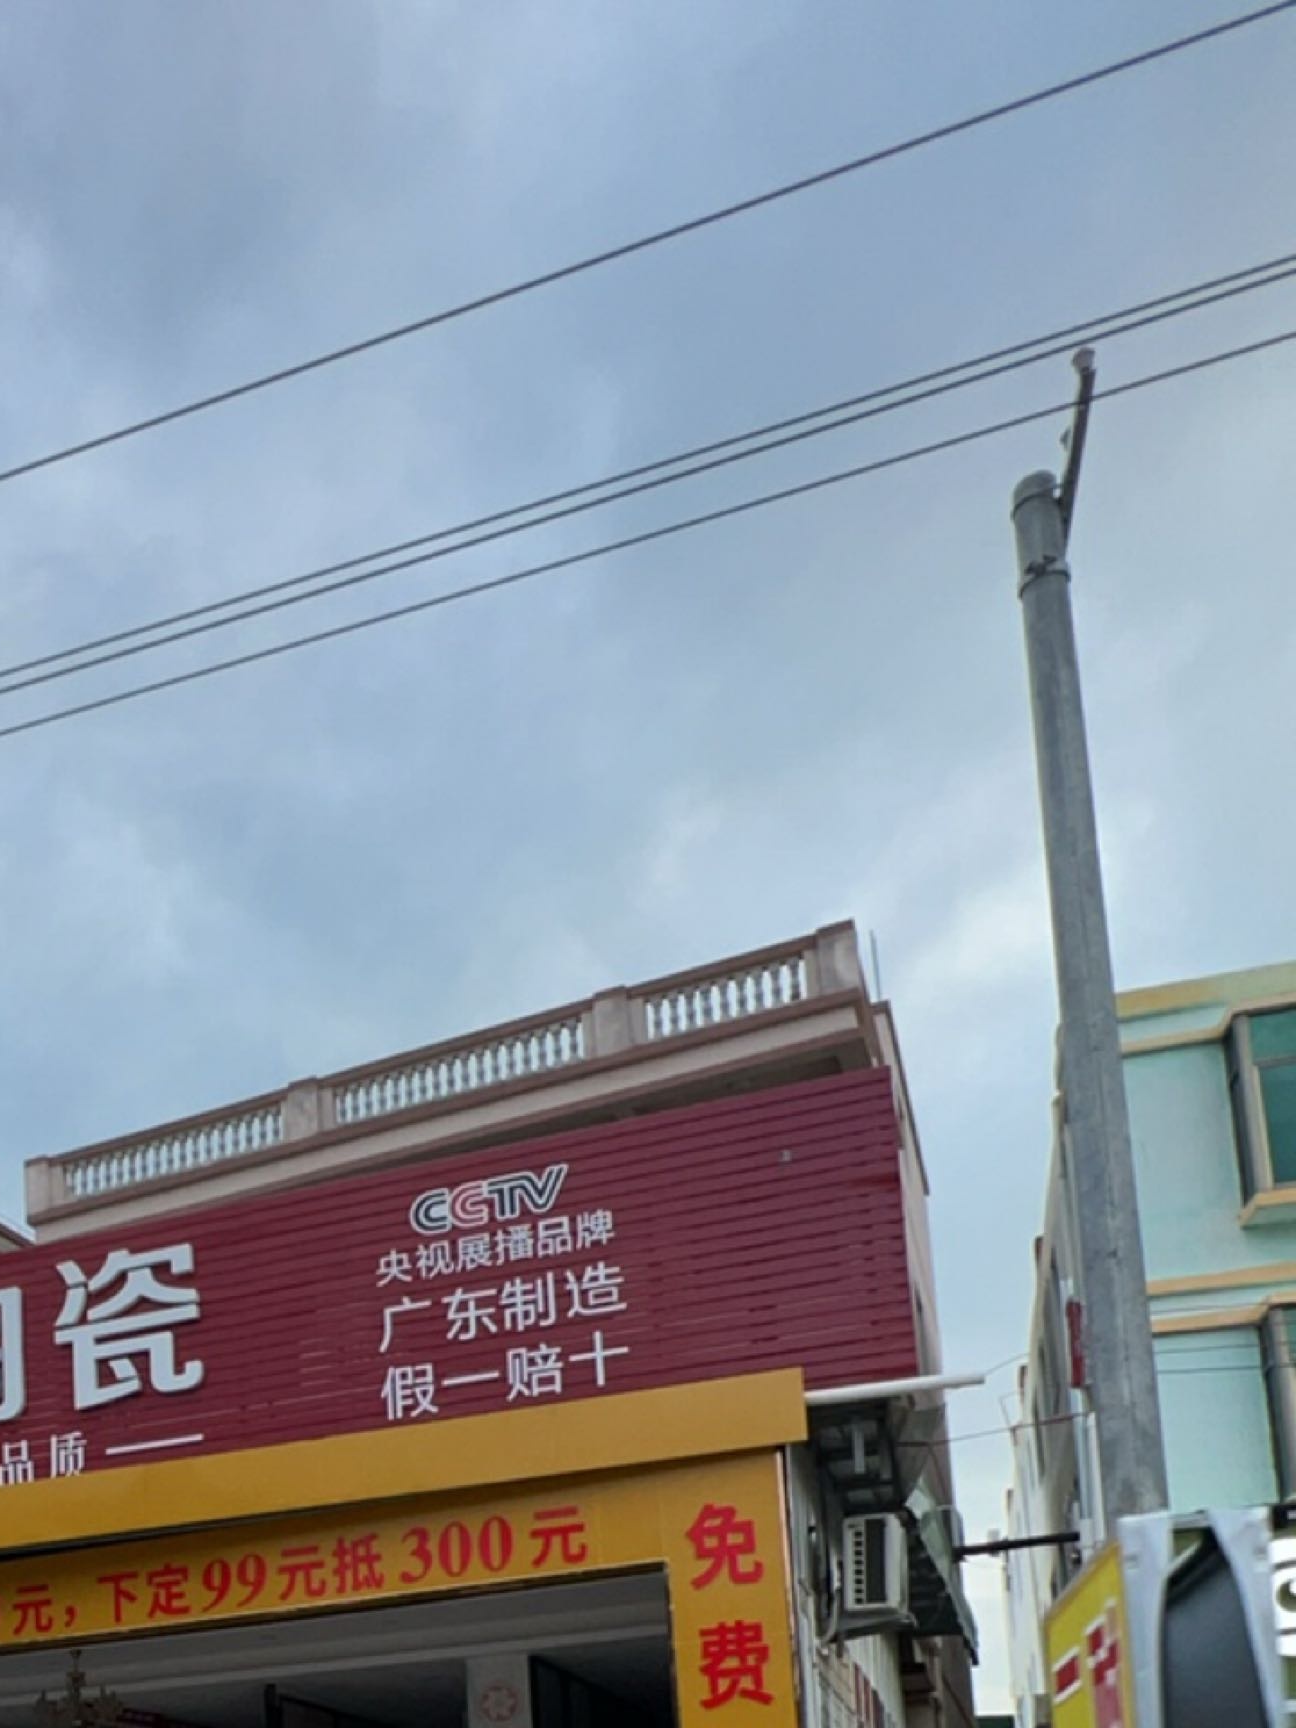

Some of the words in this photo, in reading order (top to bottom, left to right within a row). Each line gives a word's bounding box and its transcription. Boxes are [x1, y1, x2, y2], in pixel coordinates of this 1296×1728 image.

[410, 1163, 568, 1236] CCTV
[376, 1209, 616, 1288] 央视展播品牌
[379, 1262, 628, 1353] 广东制造
[381, 1331, 630, 1420] 假一赔十
